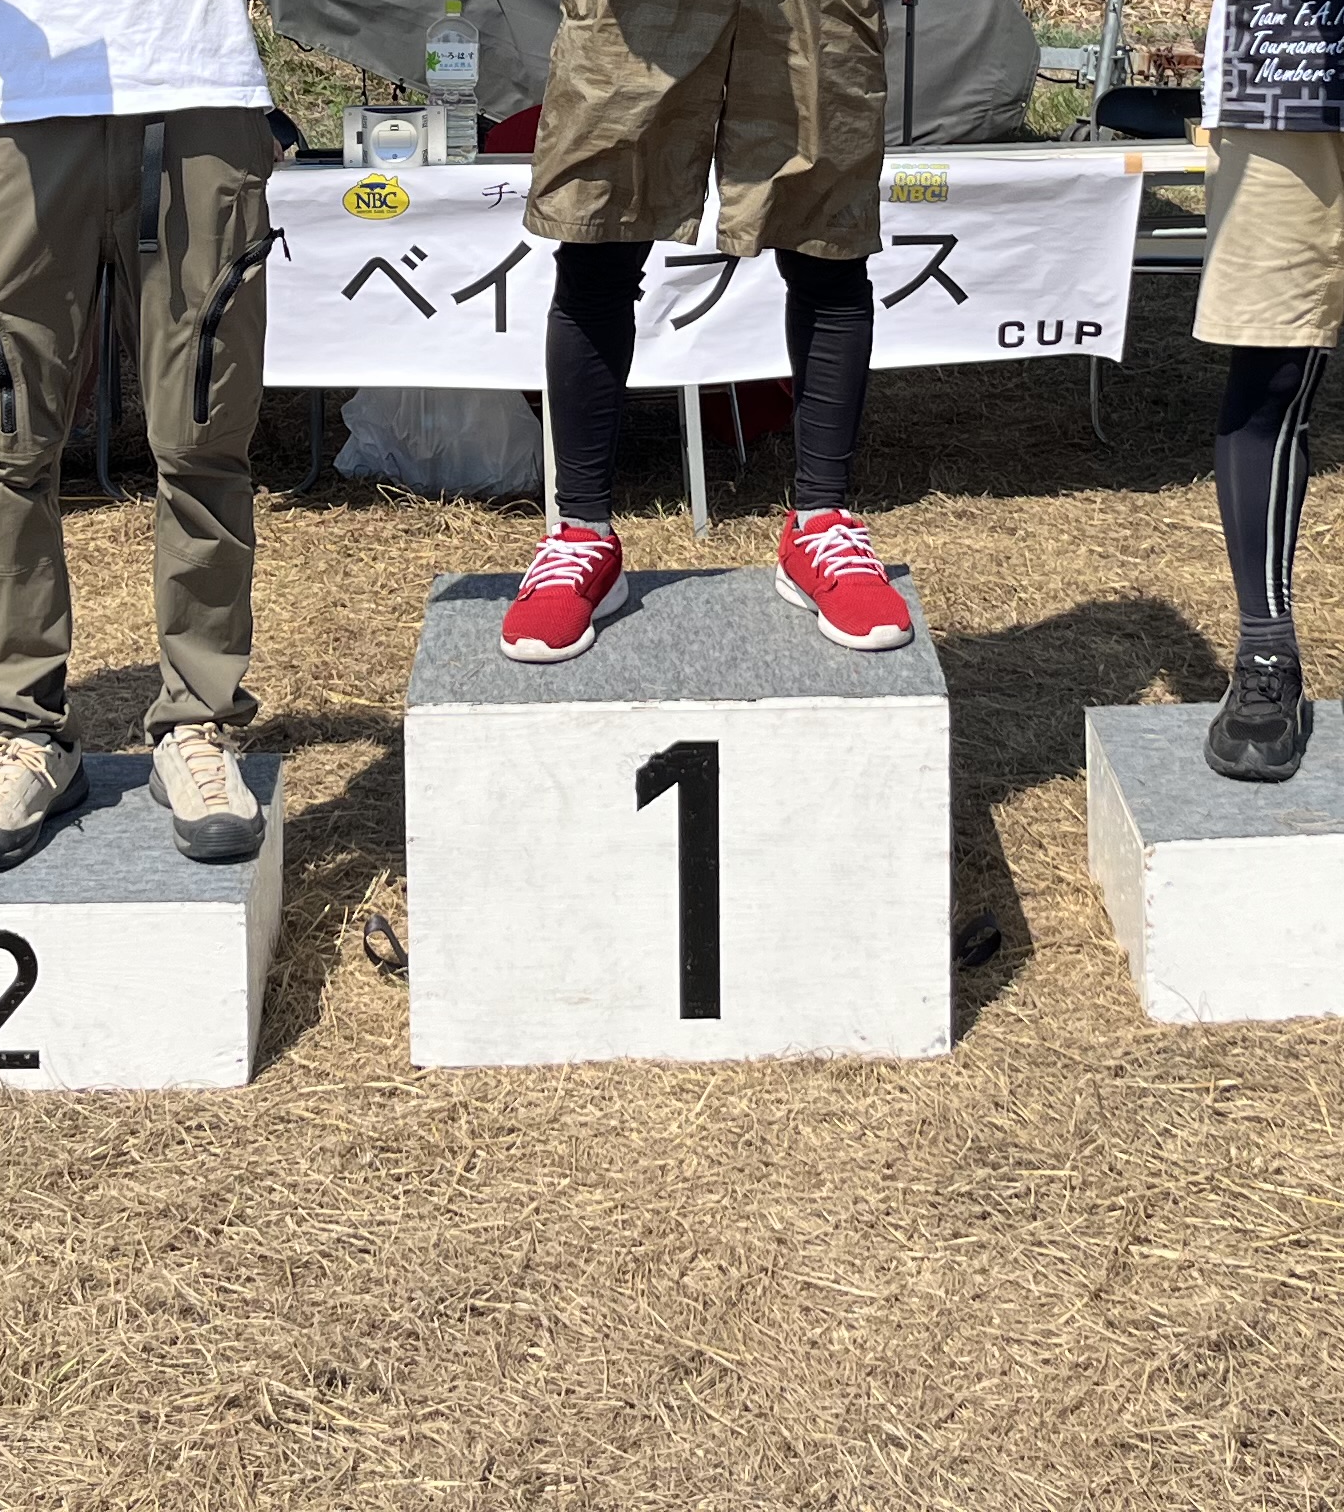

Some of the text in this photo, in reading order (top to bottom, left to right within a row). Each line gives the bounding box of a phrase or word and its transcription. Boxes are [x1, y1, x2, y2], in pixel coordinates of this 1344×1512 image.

[1250, 3, 1287, 28] Team
[1254, 58, 1336, 84] Members
[894, 171, 947, 186] Go!Go!
[354, 191, 398, 209] NBC
[889, 184, 949, 203] NBC!
[998, 320, 1103, 350] CUP
[636, 740, 721, 1020] 1
